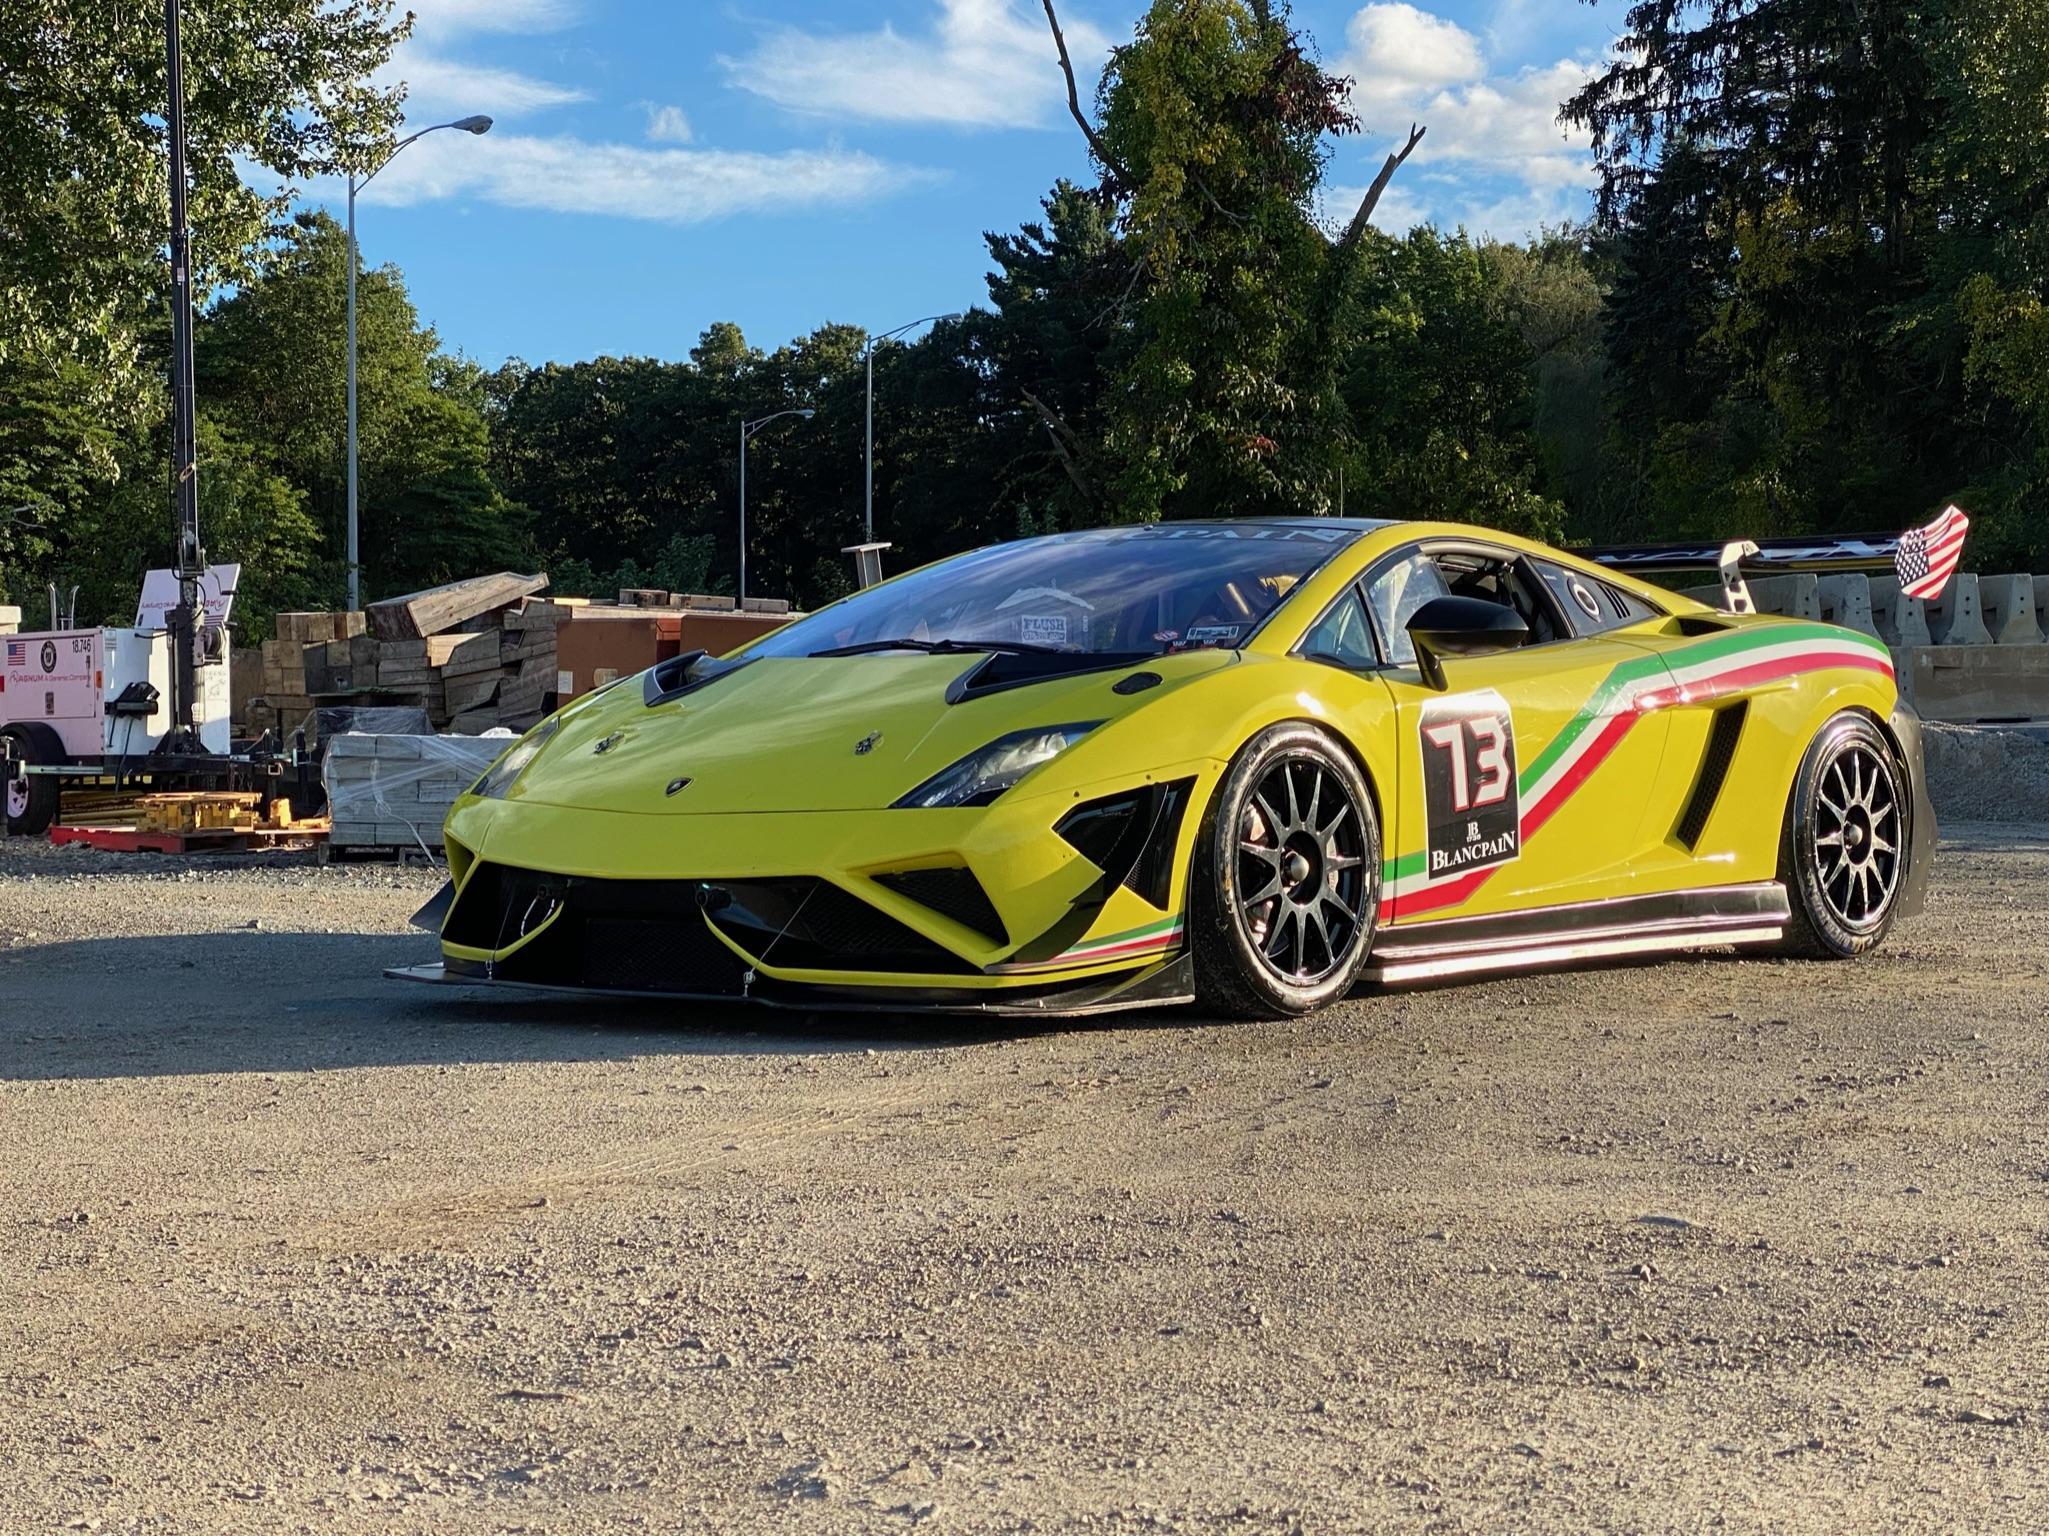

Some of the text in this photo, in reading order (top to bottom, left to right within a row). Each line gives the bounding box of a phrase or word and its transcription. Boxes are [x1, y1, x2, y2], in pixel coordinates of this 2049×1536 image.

[1024, 618, 1065, 631] FLUSH
[1420, 713, 1512, 813] 73
[1432, 830, 1516, 871] BLANCPAIN
